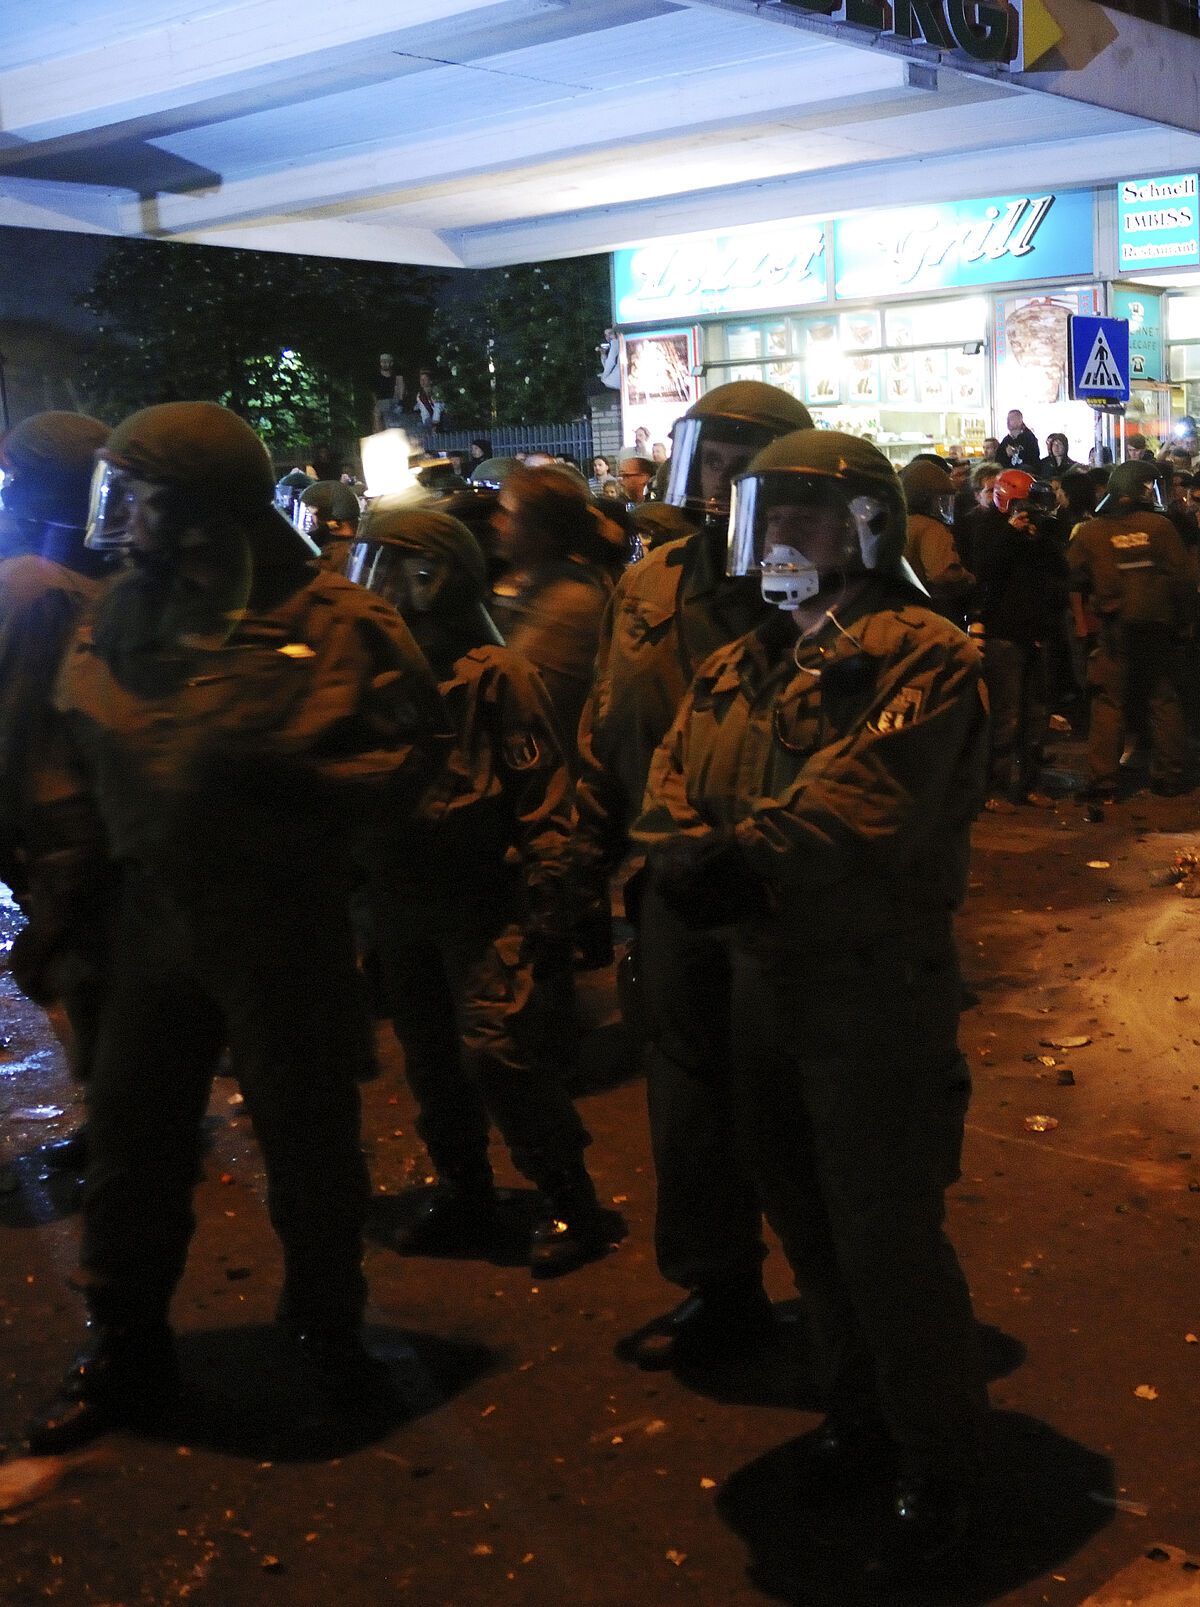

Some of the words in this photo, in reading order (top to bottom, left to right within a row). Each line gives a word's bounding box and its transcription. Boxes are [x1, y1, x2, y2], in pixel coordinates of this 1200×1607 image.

[1122, 175, 1197, 204] Schnell
[1124, 206, 1193, 232] IMBISS
[868, 195, 1057, 285] Grill
[1121, 239, 1197, 260] Restaurant
